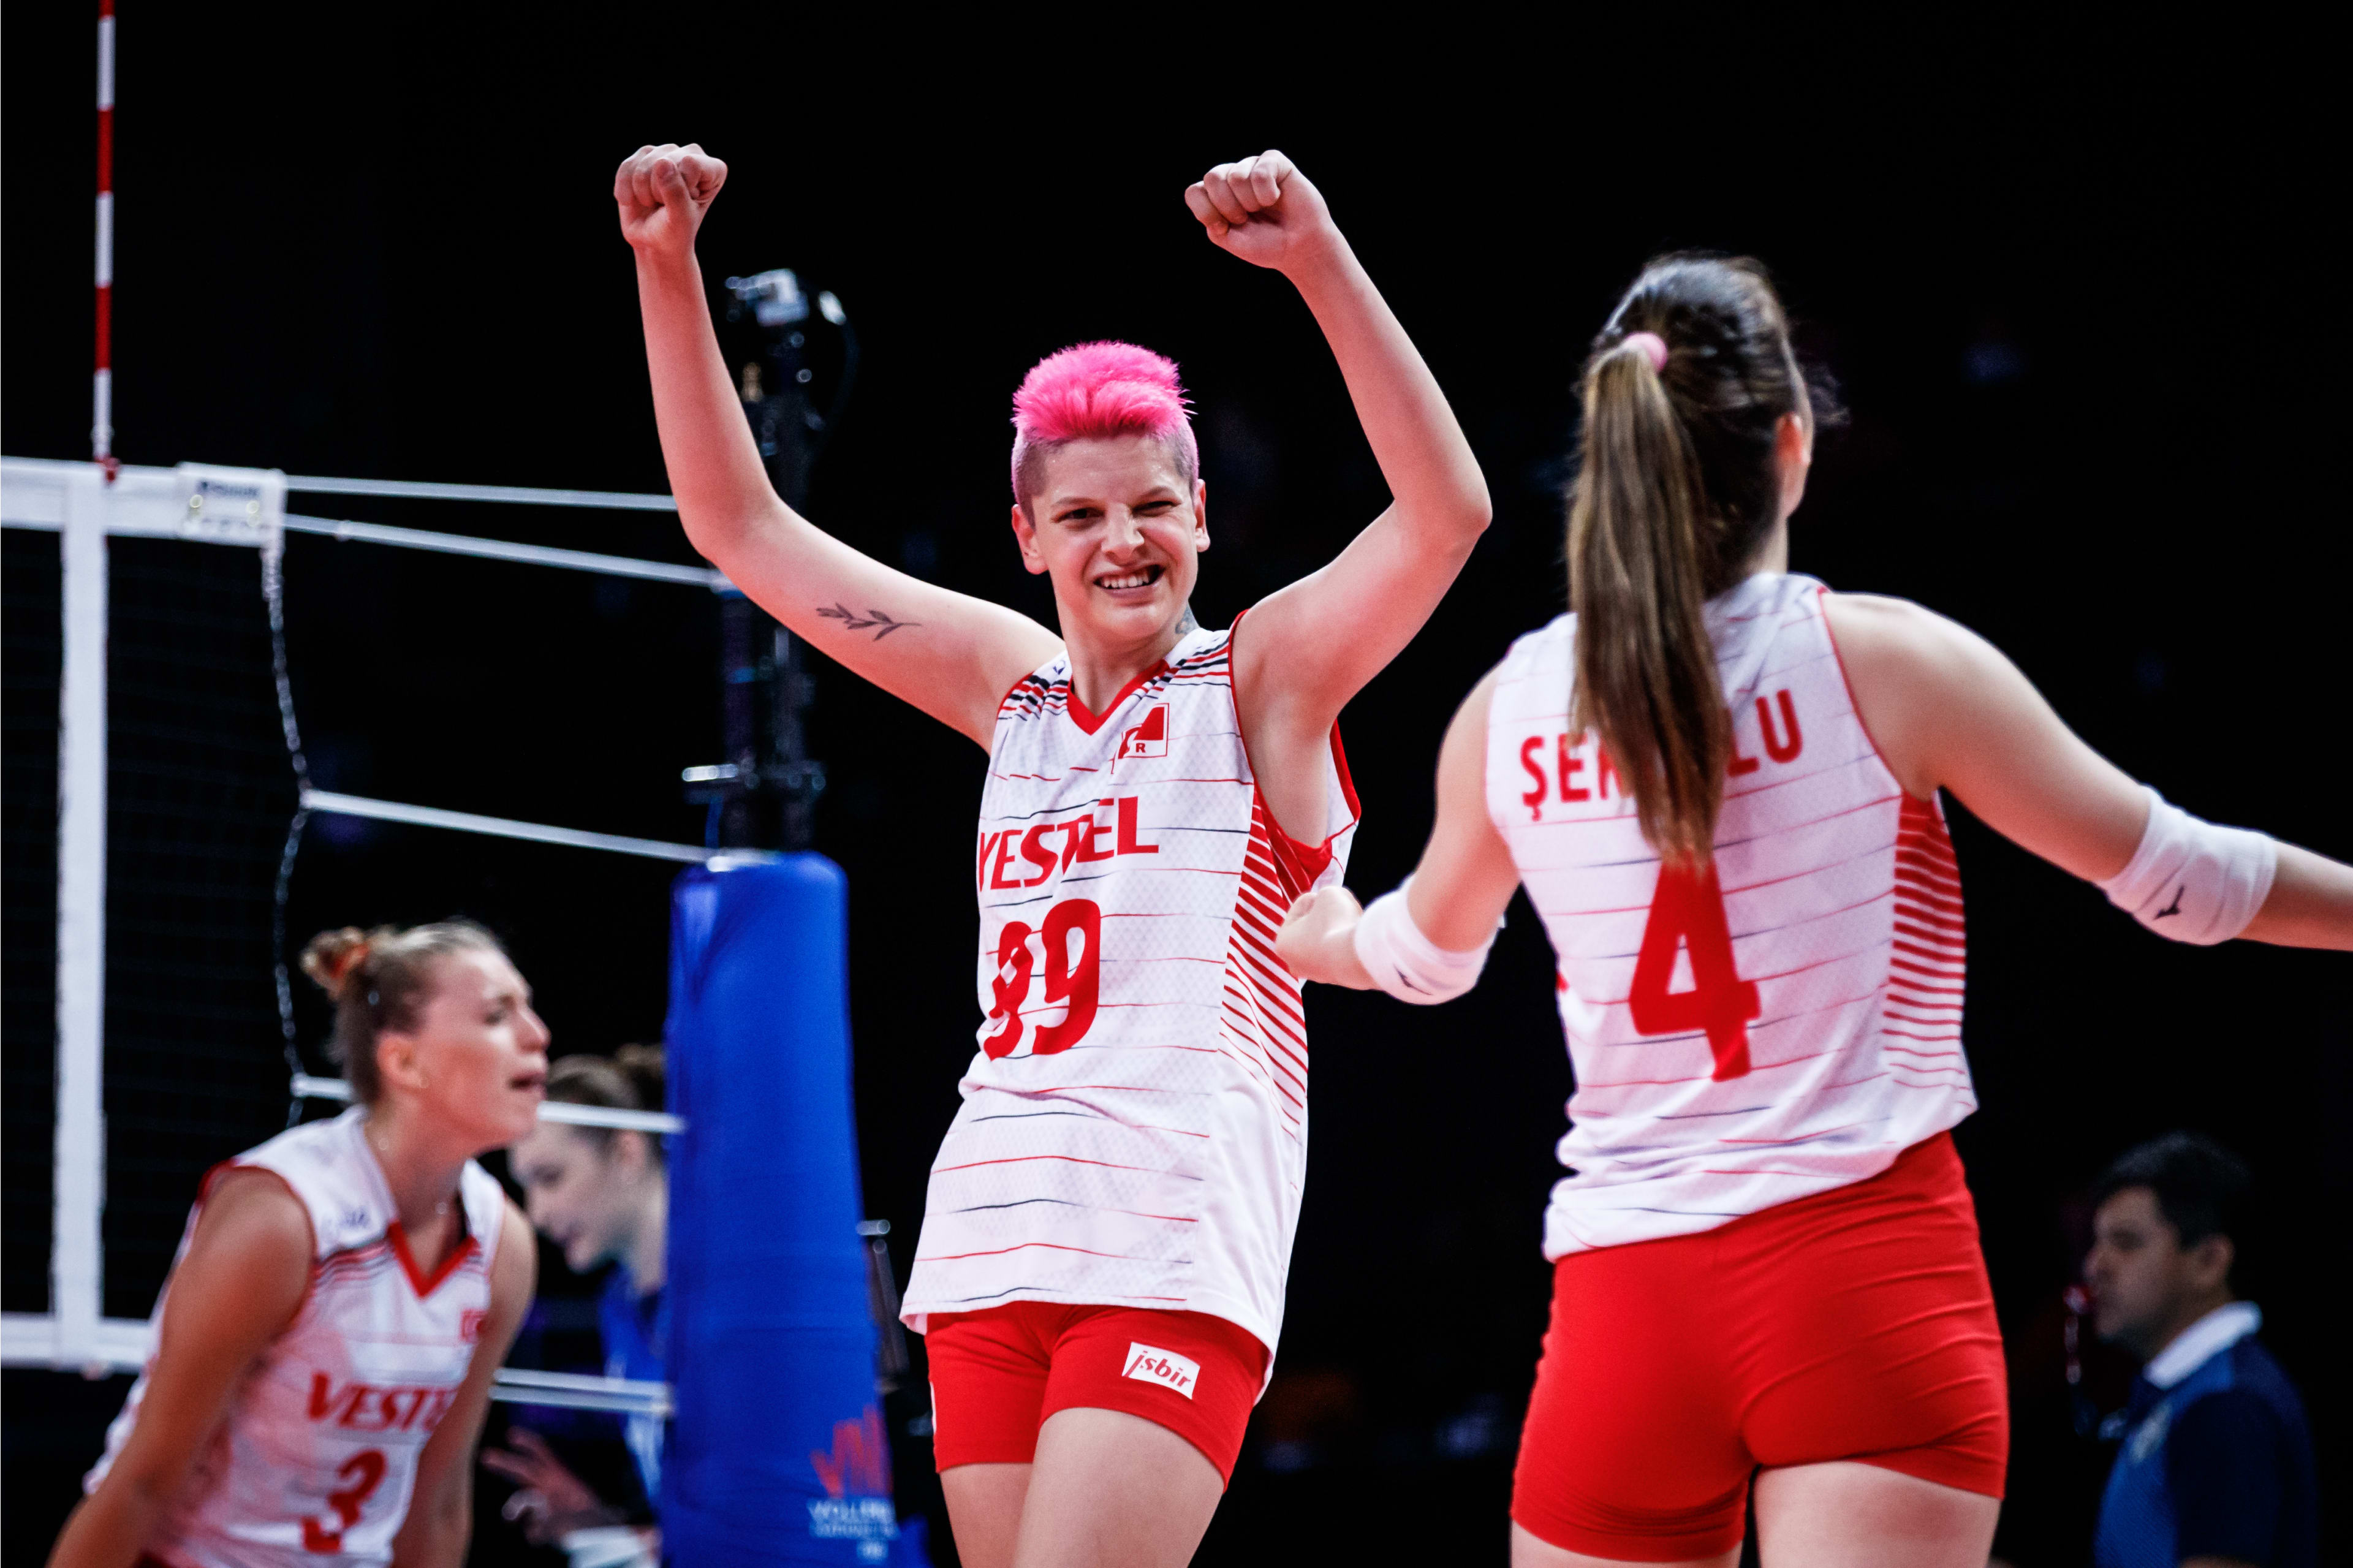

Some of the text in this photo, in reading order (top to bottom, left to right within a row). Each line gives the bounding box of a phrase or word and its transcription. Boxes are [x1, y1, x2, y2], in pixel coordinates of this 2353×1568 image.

[1629, 849, 1761, 1083] 4
[308, 1371, 460, 1432] VESTE
[302, 1449, 388, 1554] 3
